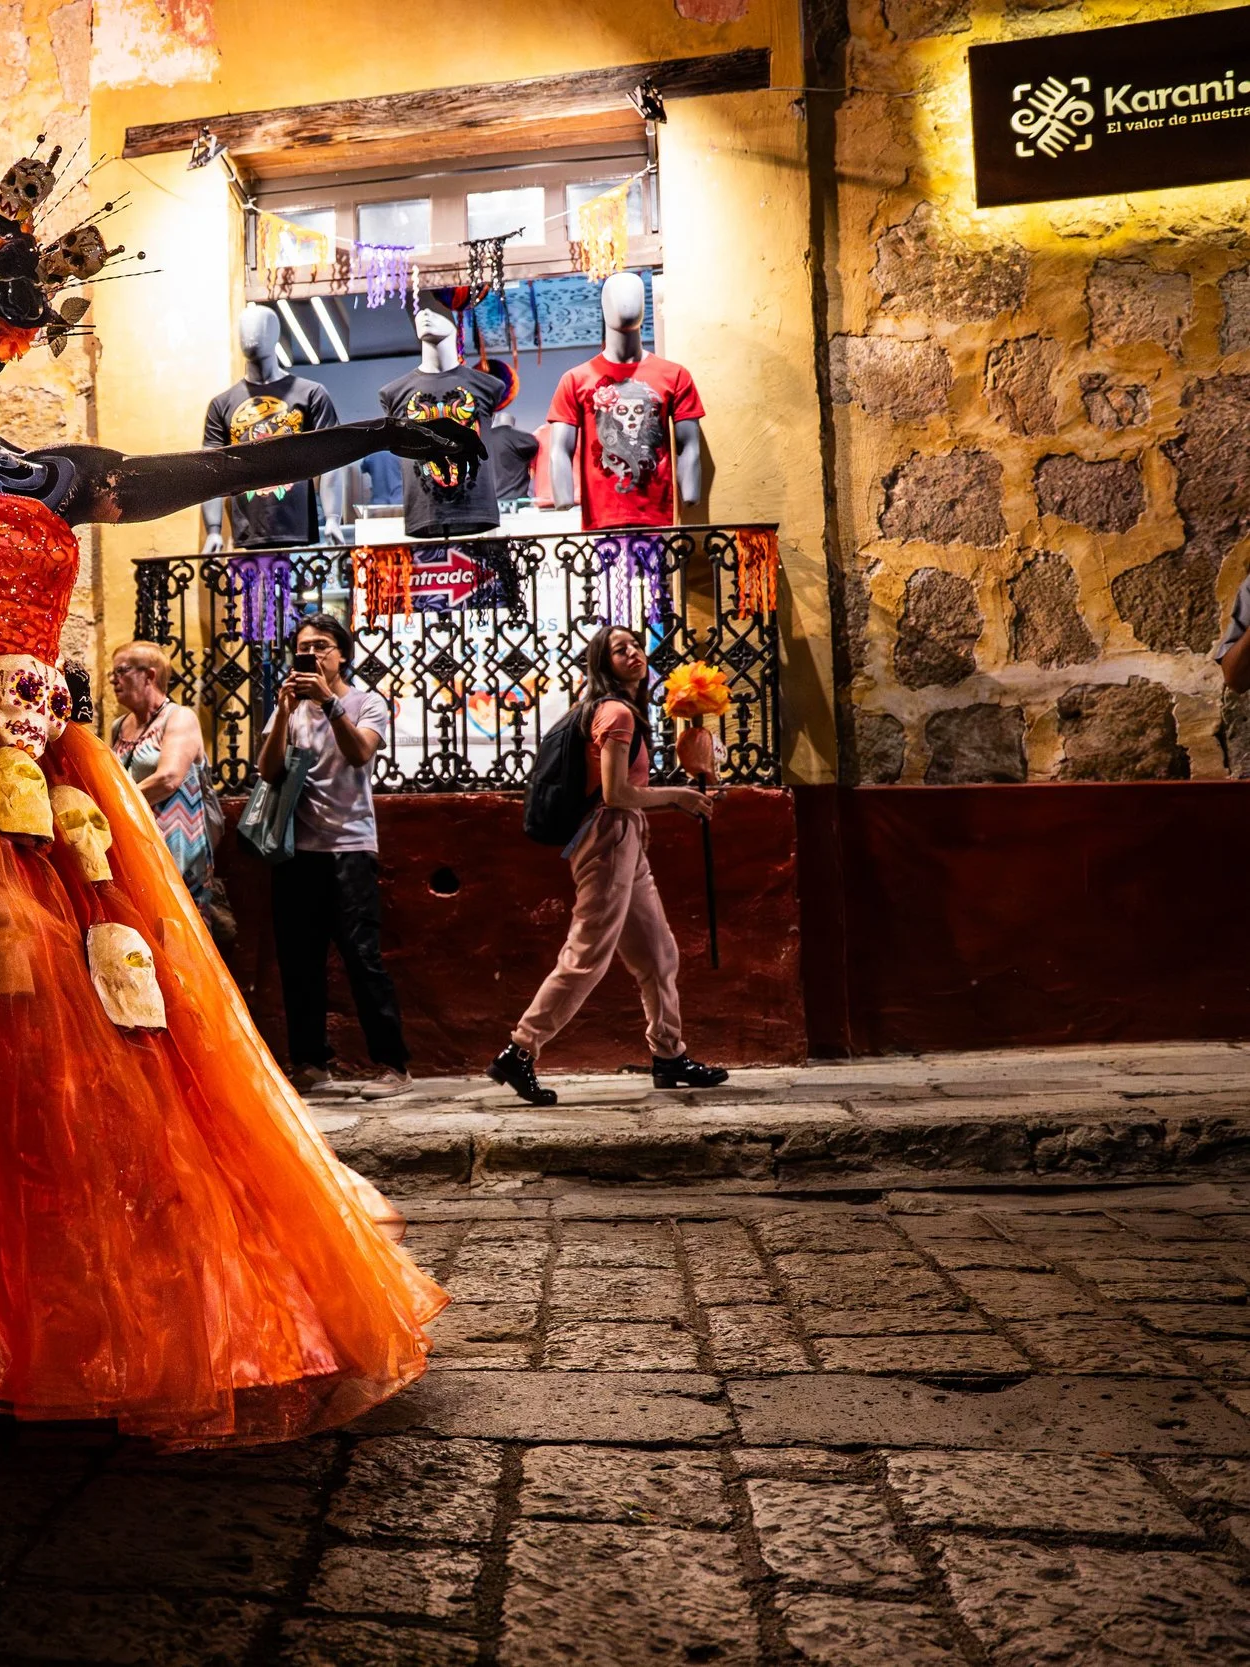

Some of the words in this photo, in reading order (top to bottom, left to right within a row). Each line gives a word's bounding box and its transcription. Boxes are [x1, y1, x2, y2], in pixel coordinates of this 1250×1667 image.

[1106, 121, 1122, 134] El
[1125, 117, 1165, 131] valor
[1168, 114, 1187, 126] de
